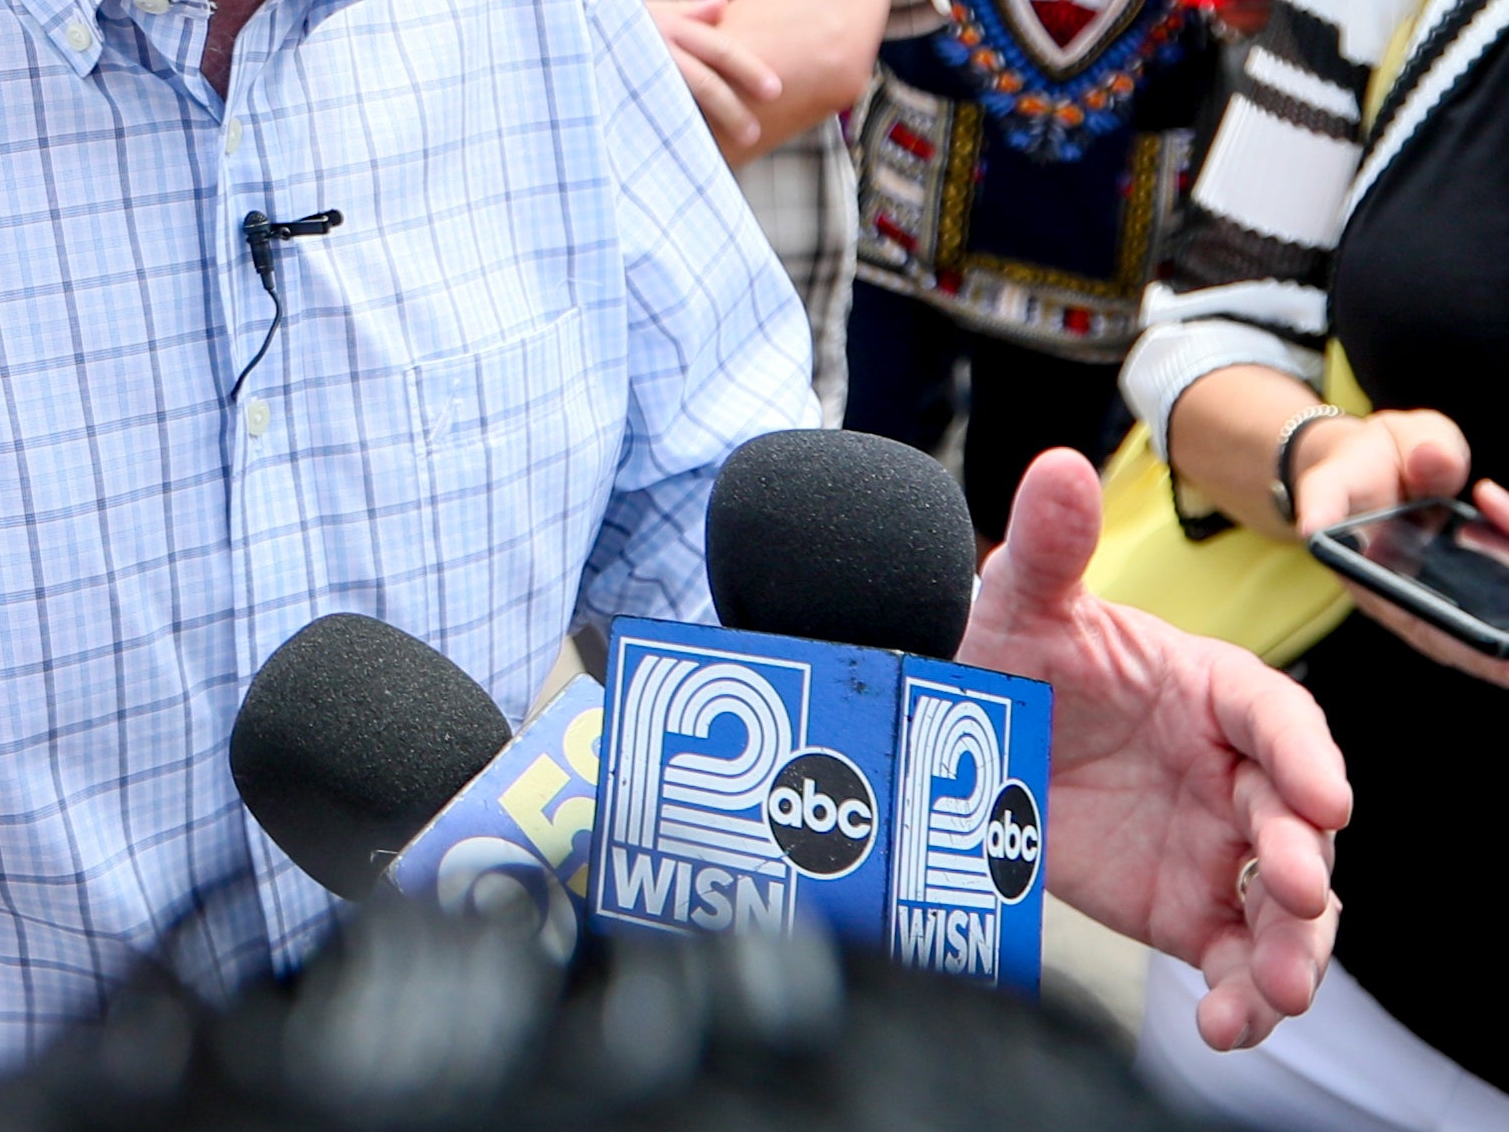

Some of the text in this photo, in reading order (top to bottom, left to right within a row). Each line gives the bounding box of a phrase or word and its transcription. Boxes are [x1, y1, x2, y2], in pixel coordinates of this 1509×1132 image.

[768, 779, 873, 840] abc
[987, 810, 1038, 863] abc
[612, 846, 785, 940] WISN
[897, 904, 995, 975] WISN
